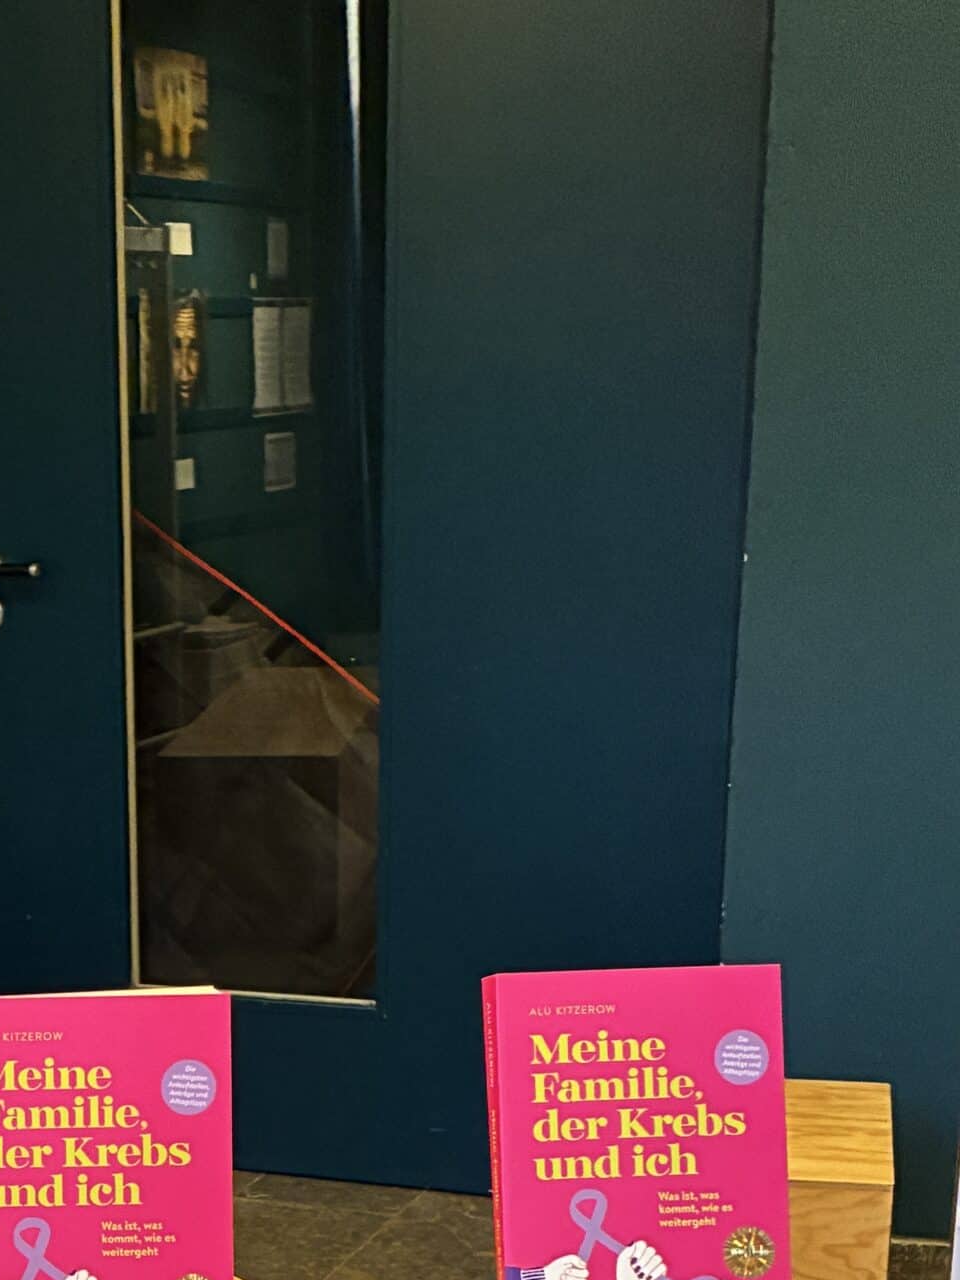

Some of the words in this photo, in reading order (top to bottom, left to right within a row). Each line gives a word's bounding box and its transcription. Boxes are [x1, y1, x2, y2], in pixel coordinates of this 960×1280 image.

[529, 1006, 552, 1015] ALU
[556, 1004, 616, 1014] KITZEROW
[3, 1031, 64, 1041] KITZEROW
[529, 1031, 665, 1065] Meine
[531, 1068, 703, 1102] Familie,
[533, 1108, 607, 1142] der
[618, 1104, 746, 1139] Krebs
[63, 1133, 191, 1167] Krebs
[534, 1145, 621, 1180] und
[632, 1143, 698, 1177] ich
[76, 1173, 143, 1206] ich
[658, 1191, 679, 1201] Was
[700, 1192, 720, 1201] was
[701, 1203, 721, 1212] wie
[722, 1204, 734, 1212] es
[101, 1221, 122, 1230] Was
[144, 1222, 163, 1231] was
[659, 1217, 717, 1228] weitergeht
[144, 1233, 163, 1243] wie
[165, 1234, 176, 1242] es
[101, 1246, 159, 1258] weitergeht
